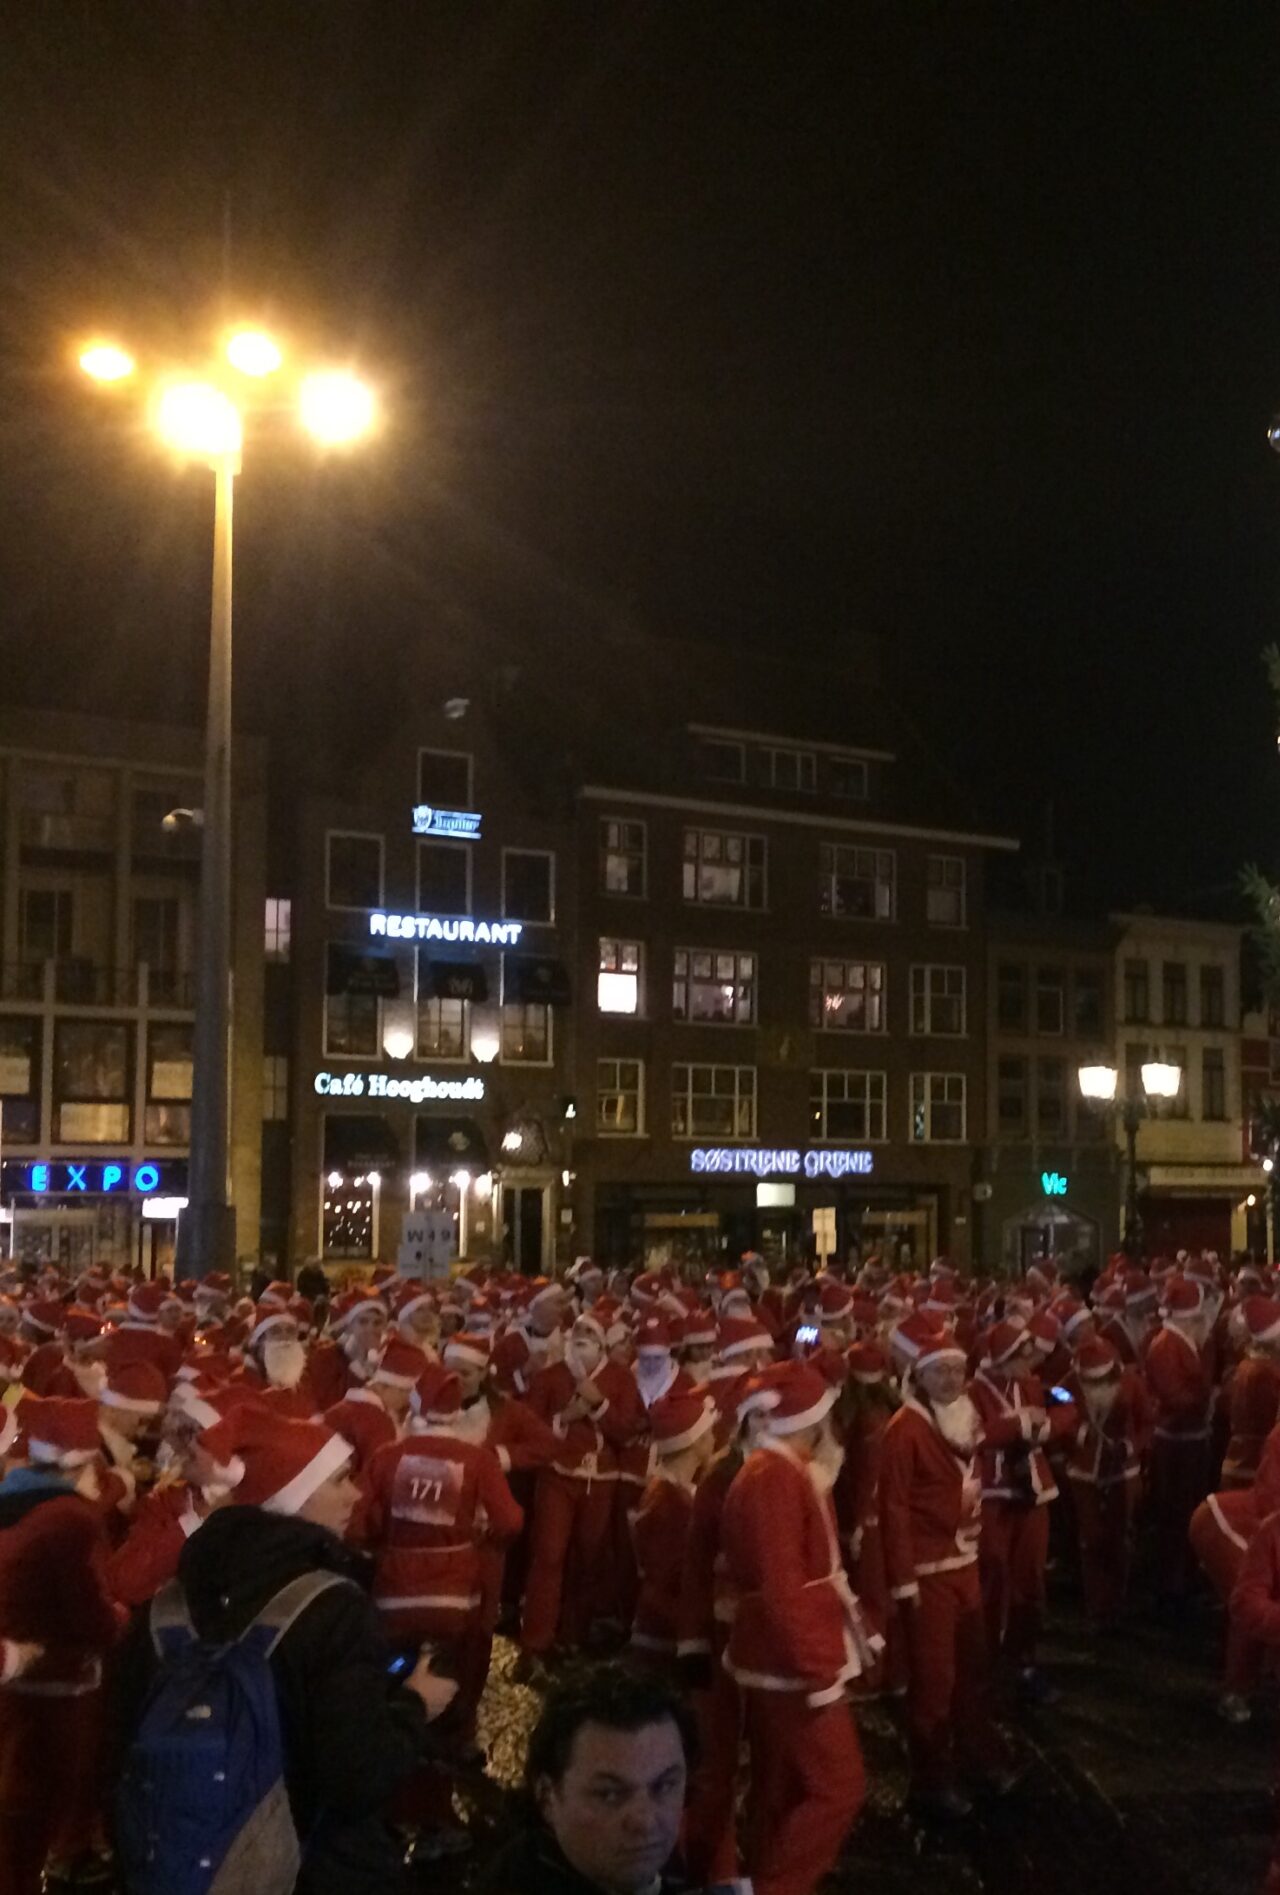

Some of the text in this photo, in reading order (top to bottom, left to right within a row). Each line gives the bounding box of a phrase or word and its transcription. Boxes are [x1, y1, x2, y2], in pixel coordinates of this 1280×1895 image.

[370, 913, 522, 944] RESTAURANT
[314, 1072, 364, 1095] Café
[31, 1165, 159, 1192] EXPO
[411, 1478, 442, 1501] 171
